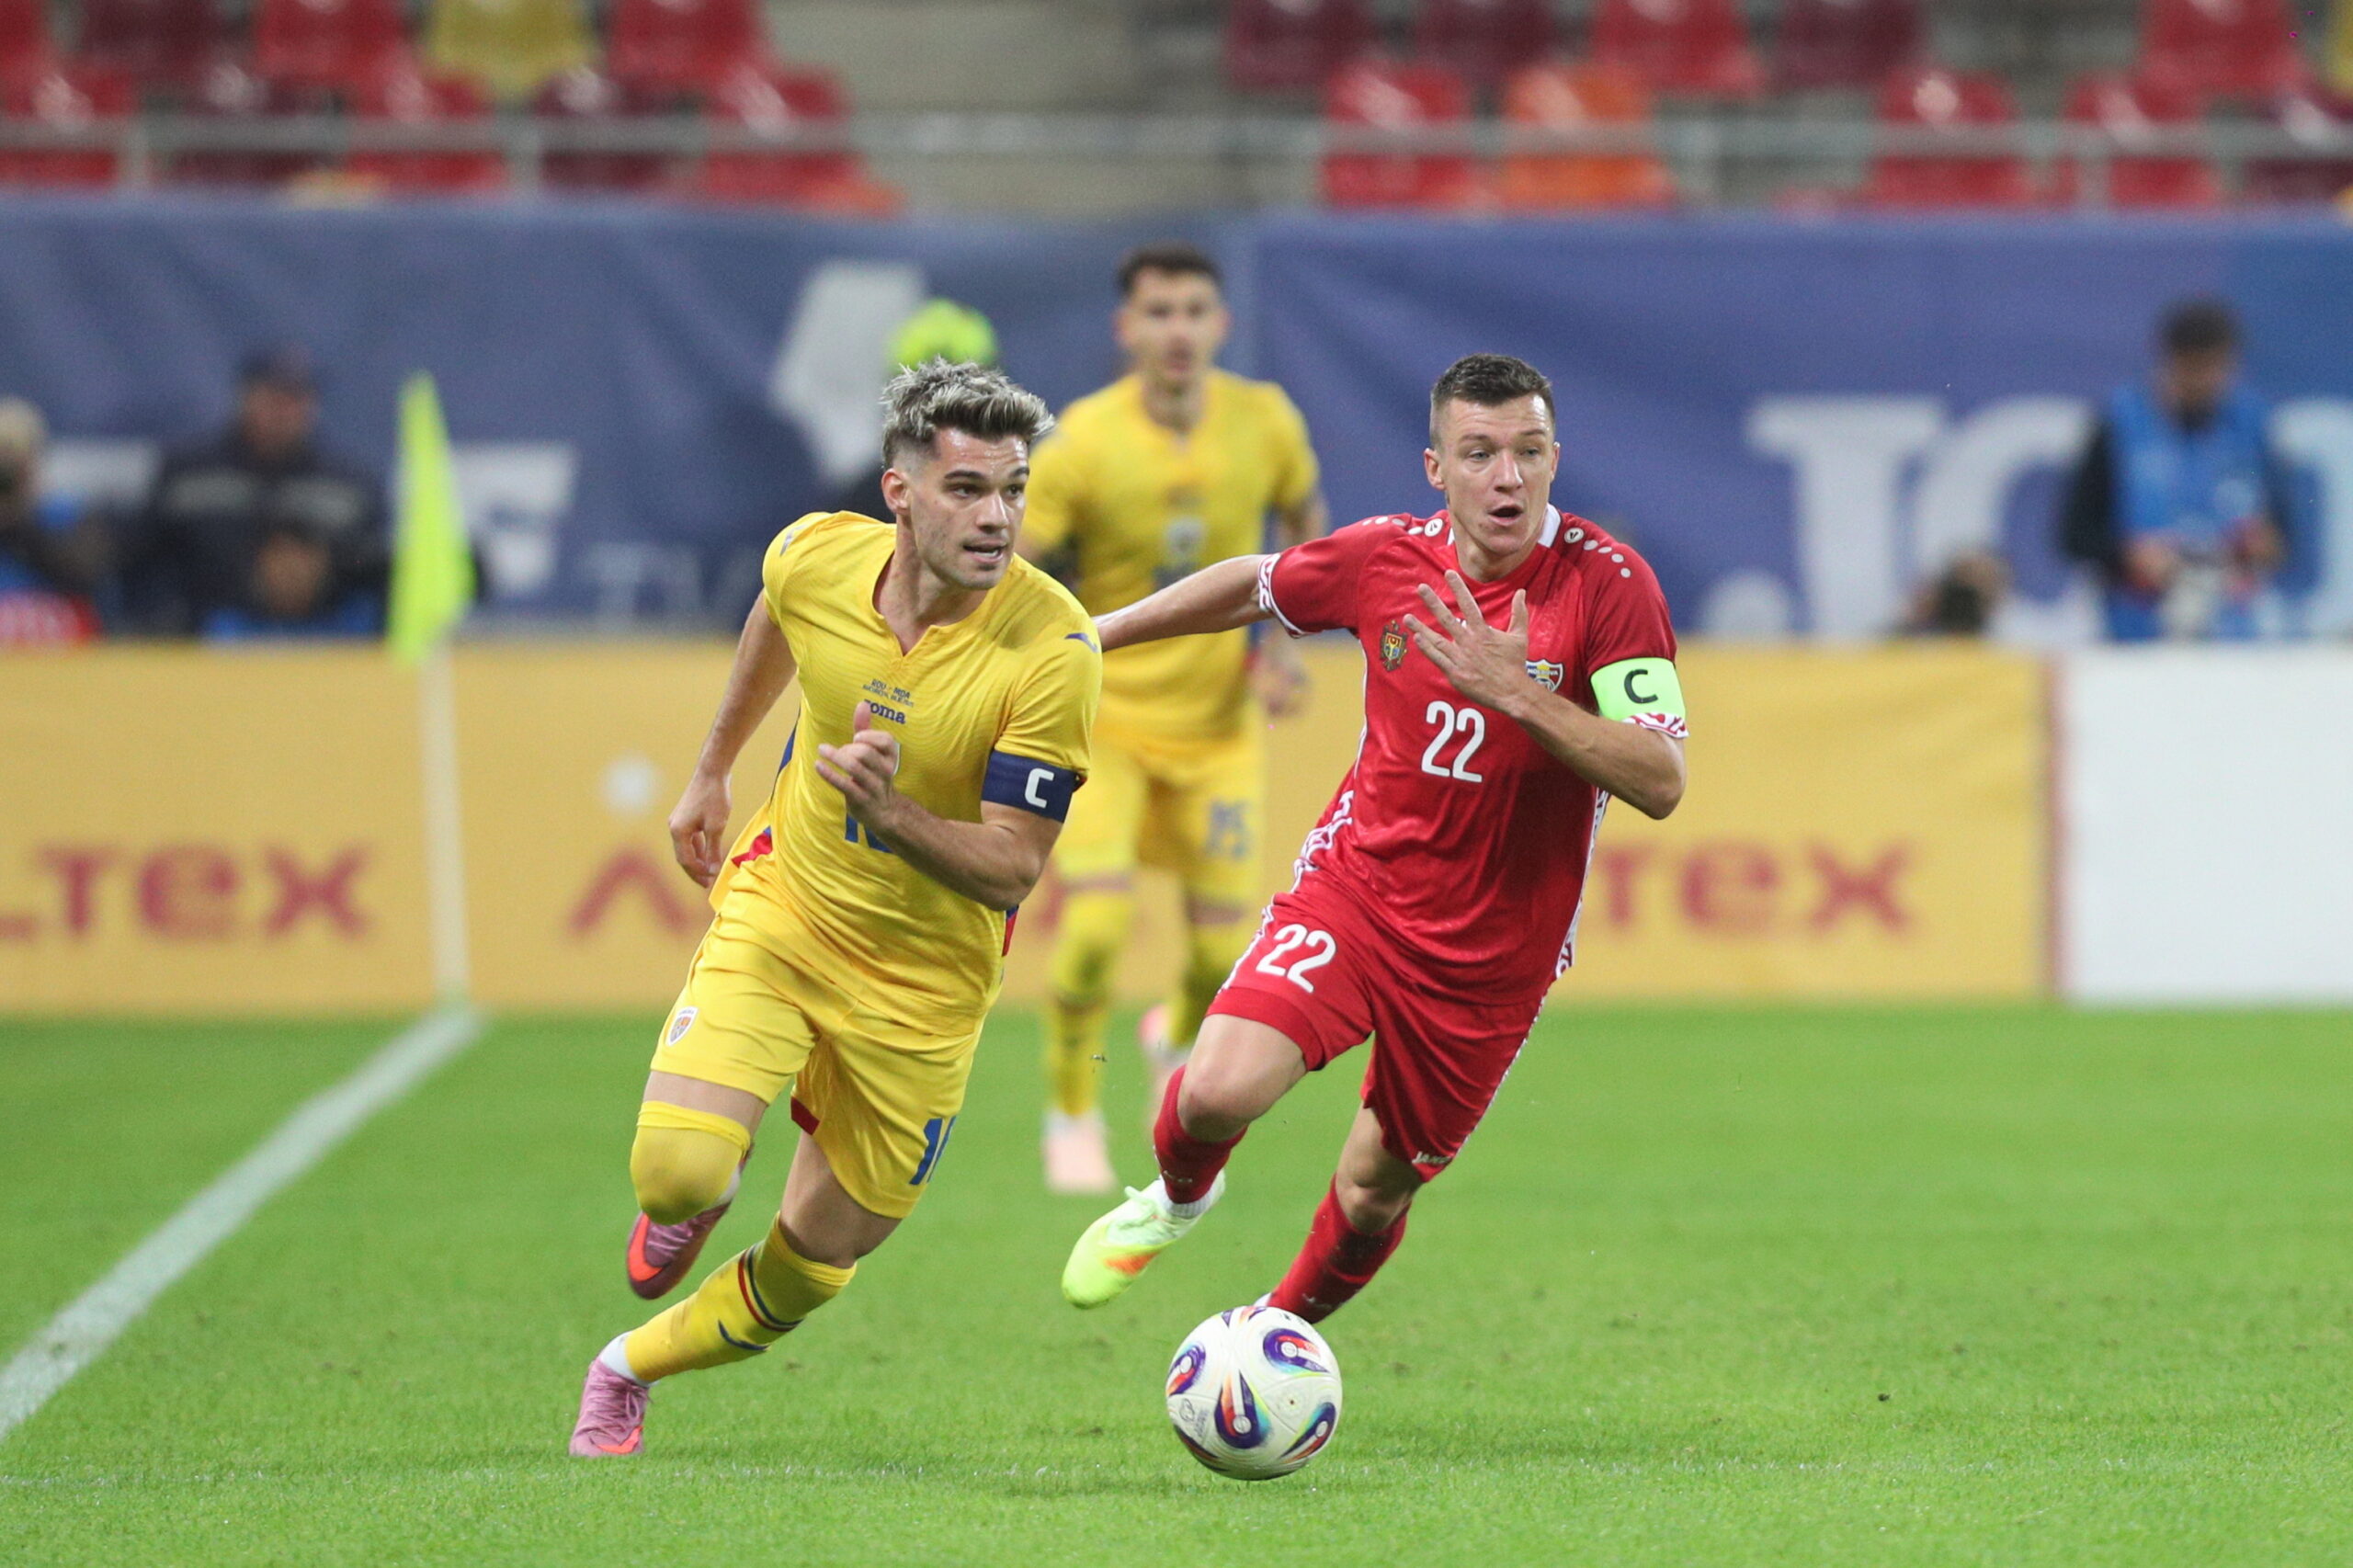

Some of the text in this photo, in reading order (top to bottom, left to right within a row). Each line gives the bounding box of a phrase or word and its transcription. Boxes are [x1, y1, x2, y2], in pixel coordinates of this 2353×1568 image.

[864, 699, 906, 725] oma
[1624, 669, 1659, 704] C
[1421, 700, 1485, 783] 22
[1024, 767, 1055, 809] C
[1256, 924, 1336, 994] 22
[908, 1115, 957, 1186] 1
